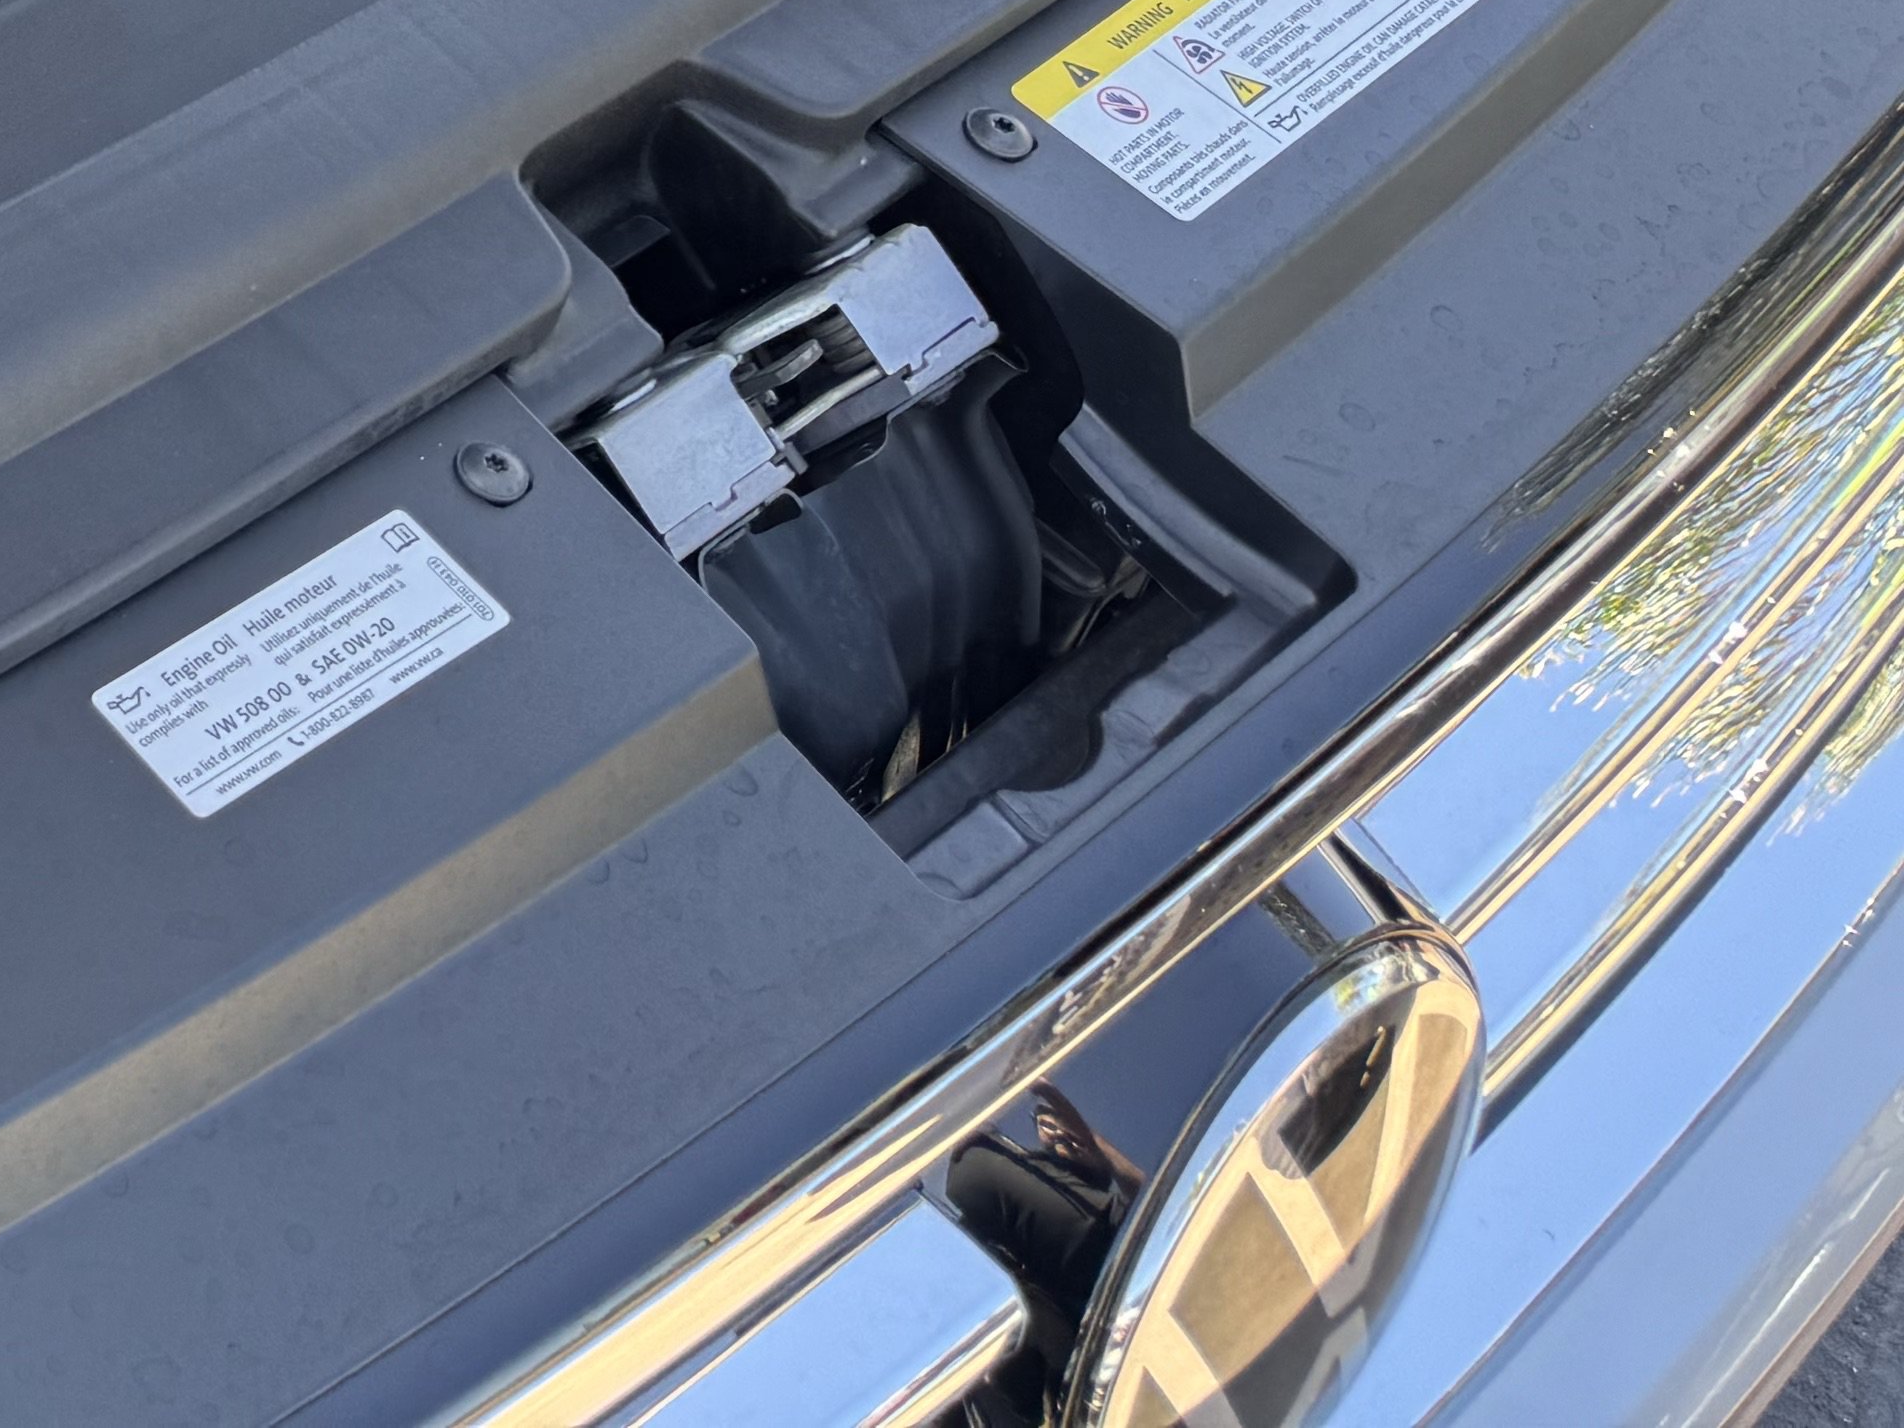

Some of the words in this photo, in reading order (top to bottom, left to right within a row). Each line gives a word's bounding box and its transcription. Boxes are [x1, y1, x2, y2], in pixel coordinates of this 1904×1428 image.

[1107, 1, 1174, 50] WARNING
[241, 608, 280, 637] Huile
[274, 573, 339, 617] moteur
[259, 624, 301, 653] Utilisez
[296, 587, 362, 632] uniquement
[355, 578, 374, 593] de
[368, 560, 403, 585] l'huile
[272, 649, 295, 667] qui
[288, 623, 333, 655] satisfait
[159, 646, 220, 690] Engine
[209, 633, 238, 656] Oil
[204, 714, 240, 742] VW
[234, 695, 270, 722] 508
[265, 680, 293, 703] 00
[292, 669, 313, 686] &
[310, 648, 346, 675] SAE
[340, 616, 397, 656] 0W-20
[307, 682, 335, 703] Pour
[332, 670, 356, 688] une
[350, 657, 376, 676] liste
[370, 634, 411, 663] d'huiles
[406, 600, 468, 643] approuvées:
[125, 716, 150, 735] Use
[144, 701, 174, 724] only
[180, 679, 208, 700] that
[202, 652, 254, 688] expressly
[136, 712, 188, 749] complies
[180, 698, 209, 719] with
[214, 748, 283, 796] www.vw.com
[387, 645, 445, 685] www.vw.ca
[173, 770, 195, 788] For
[198, 754, 220, 772] list
[227, 718, 280, 756] approved
[275, 704, 301, 723] oils:
